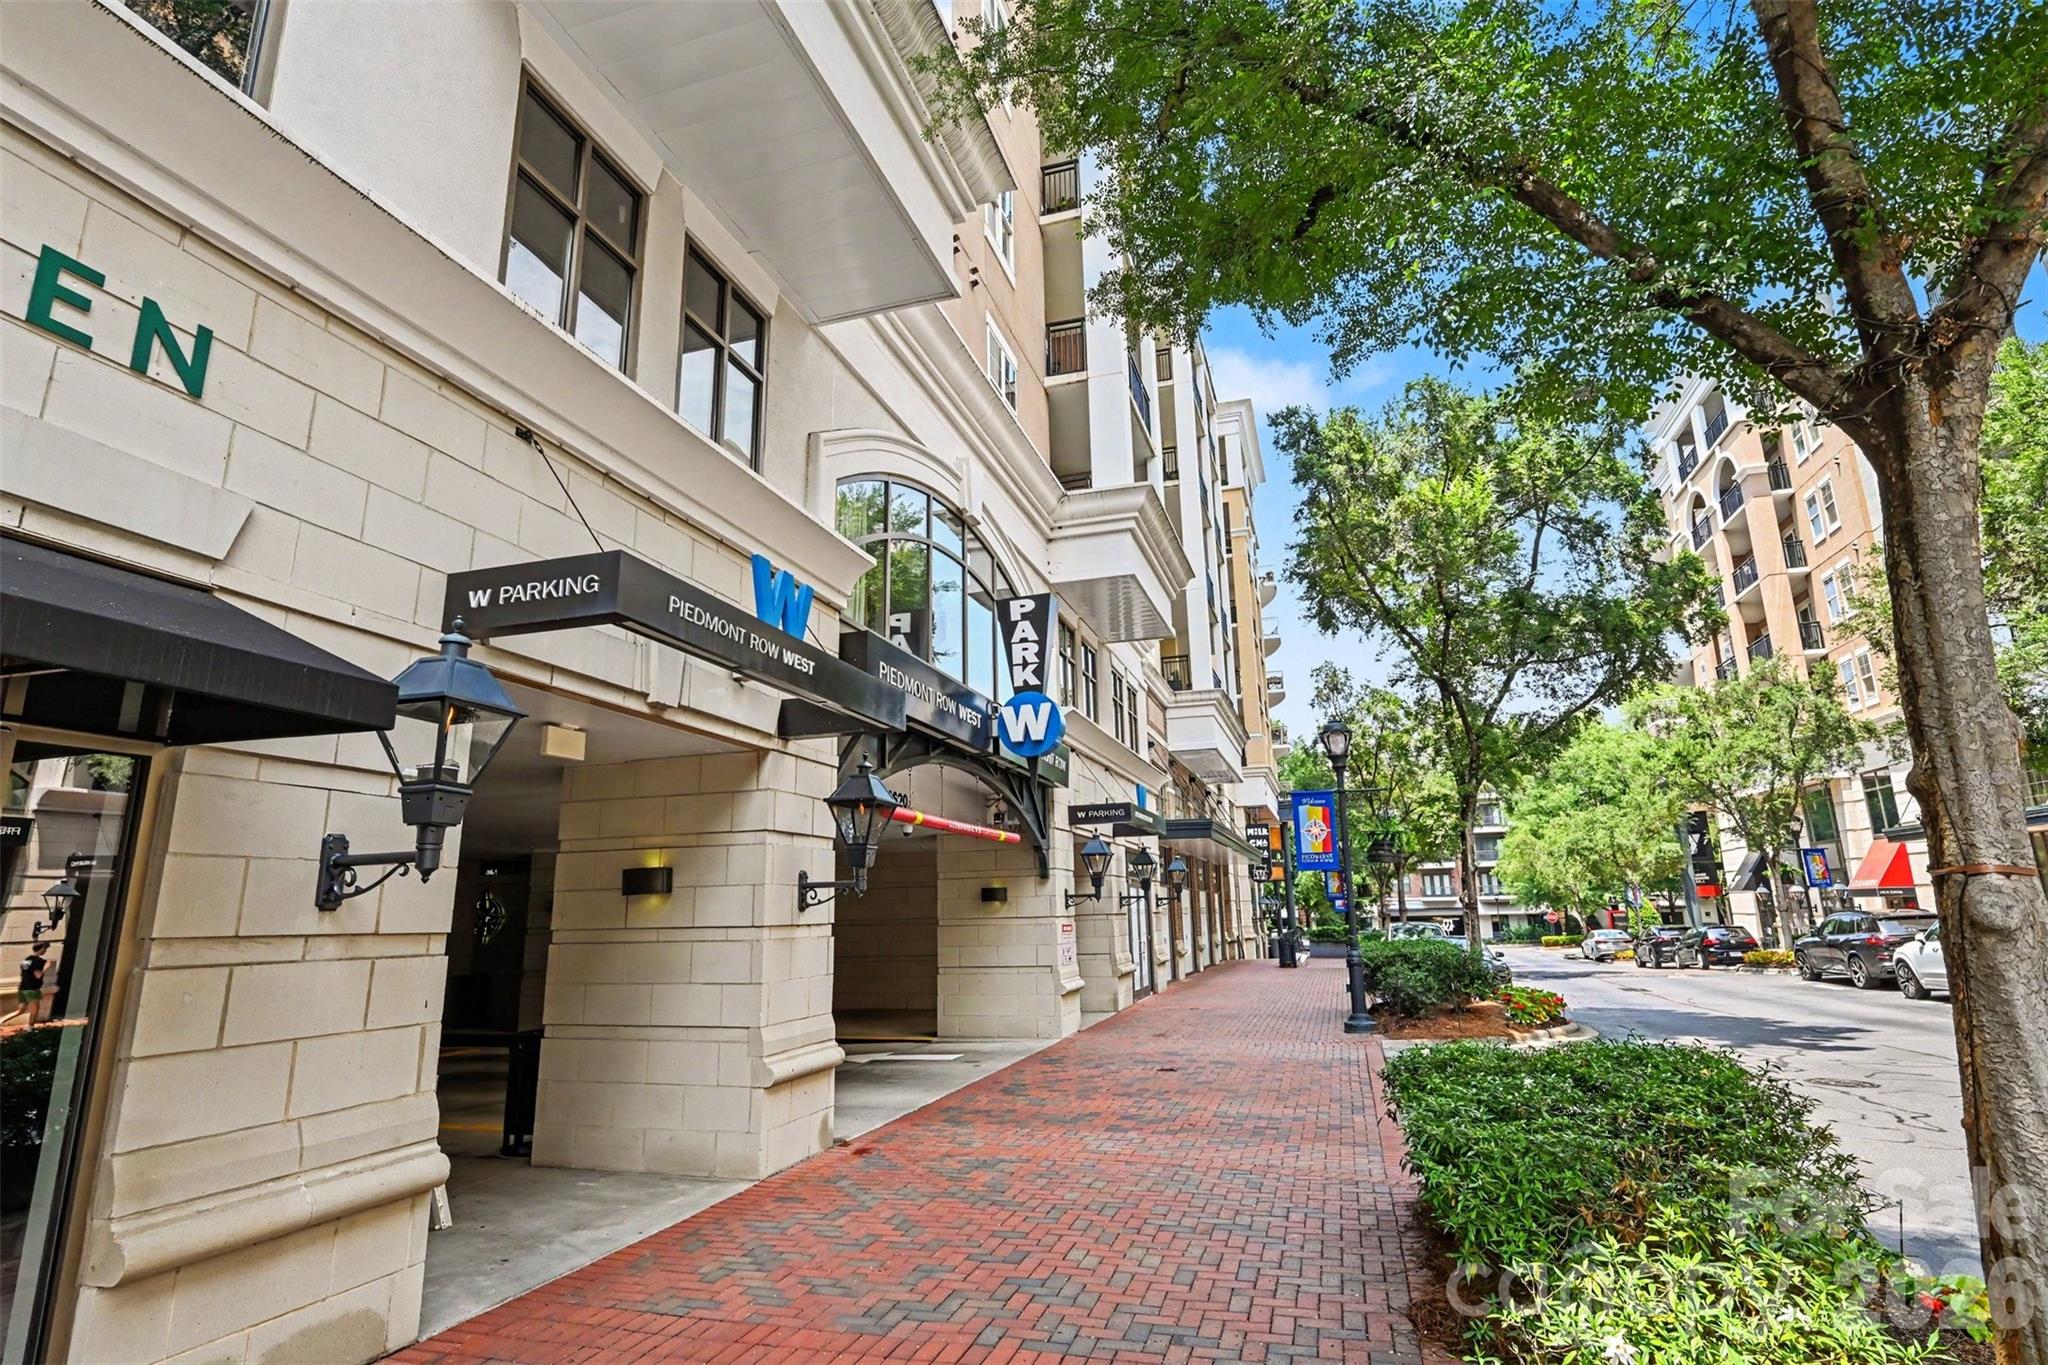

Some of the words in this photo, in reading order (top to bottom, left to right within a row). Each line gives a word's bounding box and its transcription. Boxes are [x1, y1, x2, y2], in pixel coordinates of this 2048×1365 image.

[468, 588, 492, 609] W
[499, 574, 600, 605] PARKING
[751, 552, 815, 641] W
[668, 595, 747, 645] PIEDMONT
[750, 633, 780, 660] ROW
[783, 648, 816, 676] WEST
[1008, 598, 1042, 688] PARK
[879, 661, 934, 705] PIEDMONT
[936, 691, 956, 715] ROW
[958, 704, 982, 728] WEST
[1001, 702, 1052, 743] W
[1077, 811, 1086, 819] W
[1089, 808, 1125, 818] PARKING
